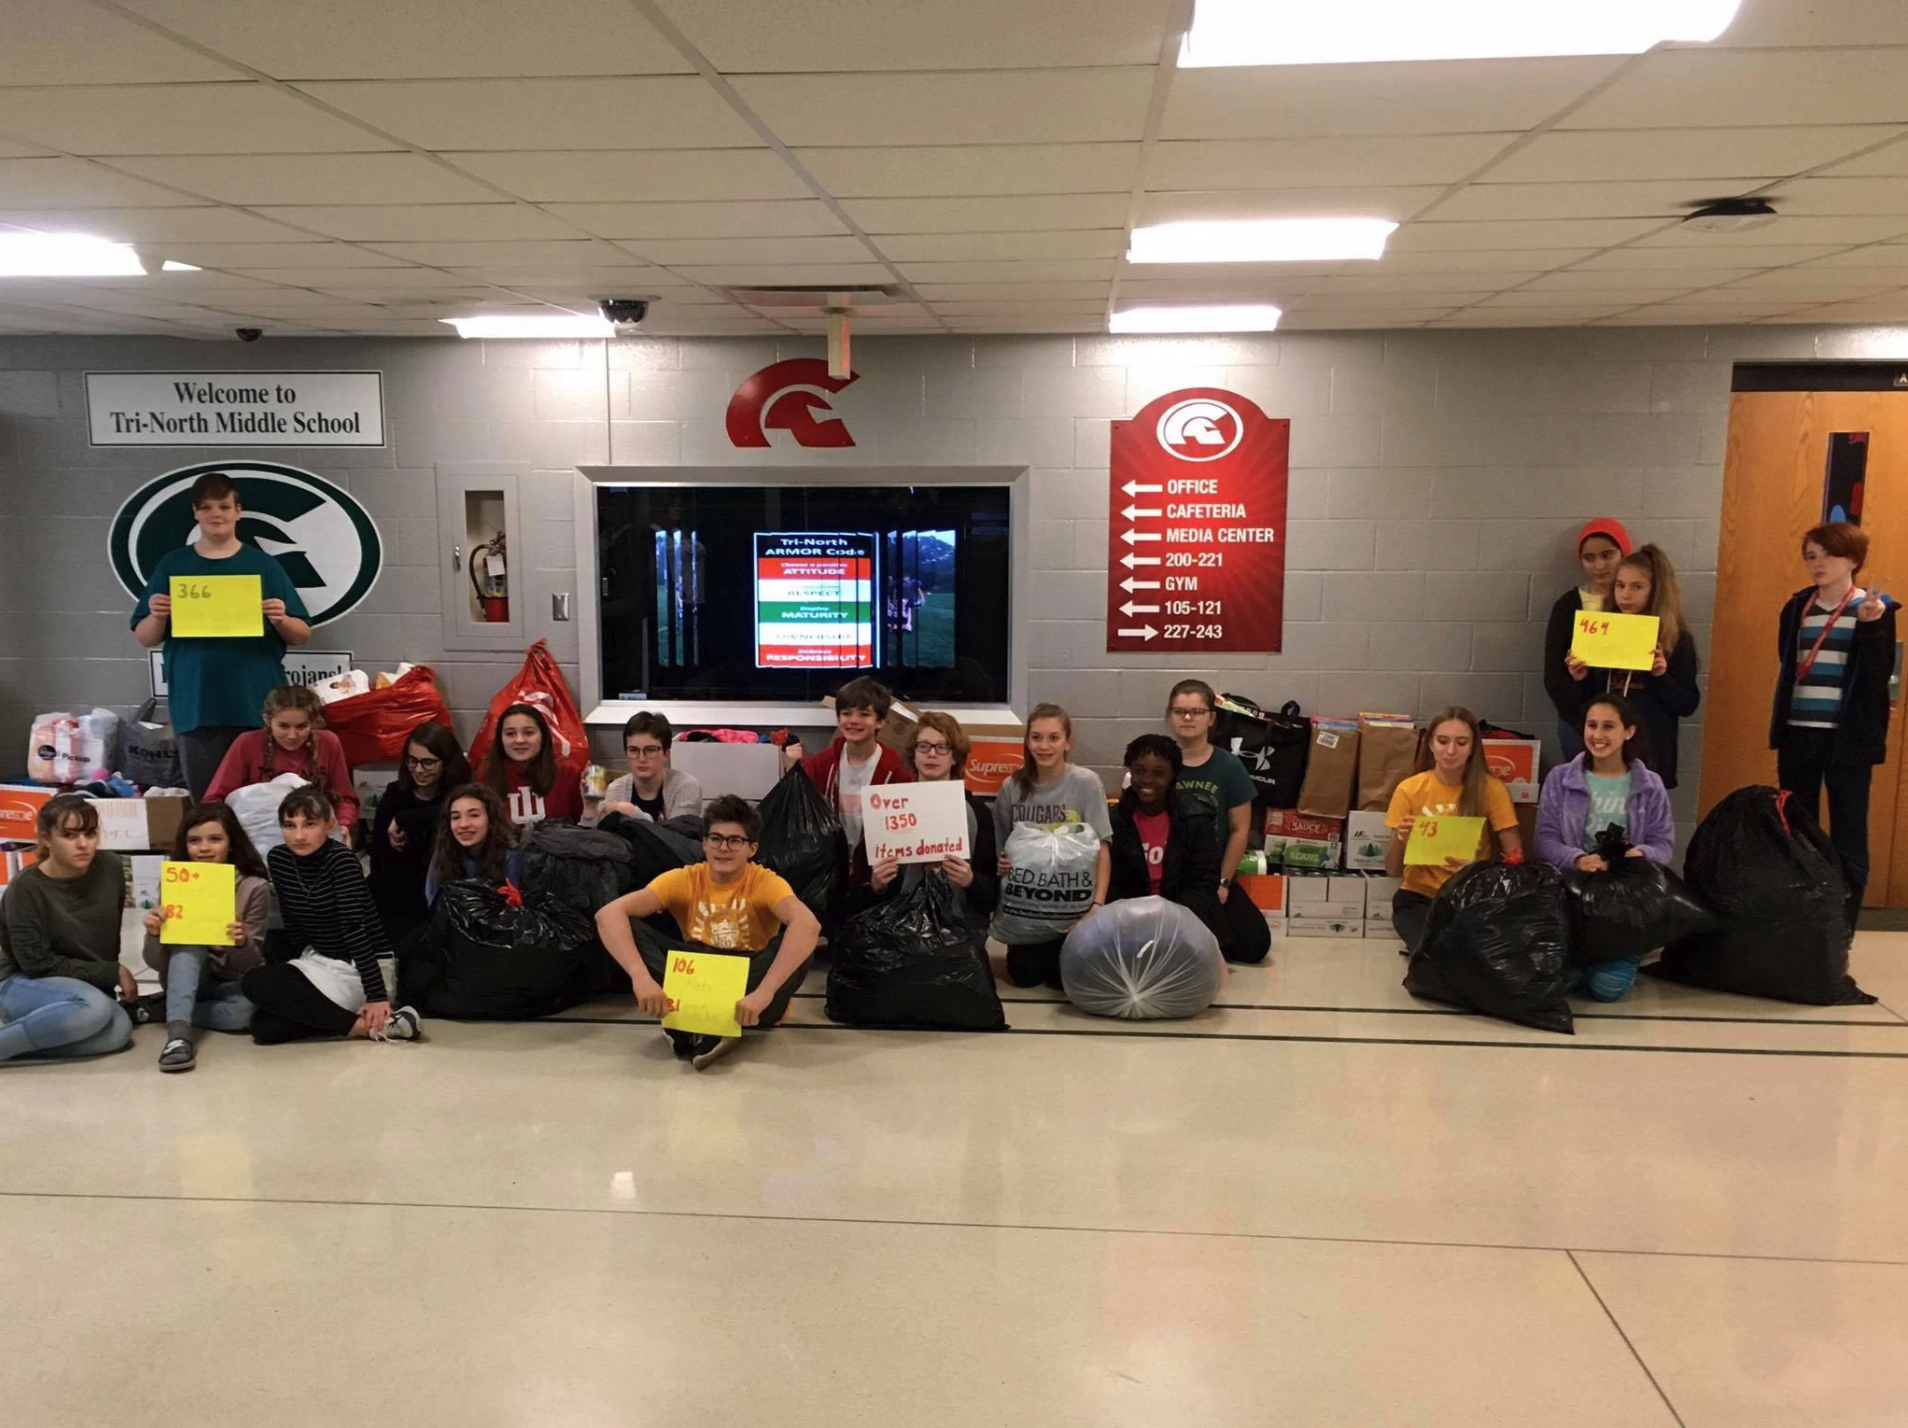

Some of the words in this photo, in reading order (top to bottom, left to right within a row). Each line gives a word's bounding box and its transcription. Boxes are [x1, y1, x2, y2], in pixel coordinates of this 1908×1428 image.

[173, 382, 269, 404] Welcome
[276, 382, 296, 404] to
[110, 411, 209, 434] Tri-North
[215, 411, 288, 434] Middle
[292, 411, 360, 434] School
[1167, 479, 1218, 495] OFFICE
[1166, 504, 1247, 519] CAFETERIA
[780, 538, 848, 546] Tri-North
[1166, 528, 1213, 543] MEDIA
[1217, 528, 1275, 543] CENTER
[765, 548, 822, 556] ARMOR
[826, 548, 865, 556] Code
[1165, 553, 1222, 567] 200-221
[177, 583, 212, 599] 366
[1165, 576, 1198, 591] GYM
[782, 611, 848, 619] MATURITY
[1164, 601, 1222, 615] 105-121
[1163, 624, 1223, 639] 227-243
[1579, 618, 1610, 636] 464
[766, 654, 866, 662] RESPONSIBILITY
[285, 665, 342, 688] ojans!
[969, 758, 1018, 777] Suprem
[1175, 780, 1220, 794] AWNEE
[869, 793, 909, 810] Over
[884, 813, 918, 831] 1350
[1291, 821, 1321, 834] SAUCE
[1419, 819, 1438, 838] 43
[875, 843, 913, 859] items
[915, 836, 963, 856] donated
[1289, 851, 1319, 861] BEANS
[166, 867, 200, 883] 50+
[1008, 867, 1036, 885] BED
[1037, 871, 1080, 888] BATH
[1081, 871, 1094, 888] &
[1005, 882, 1093, 903] BEYOND
[165, 904, 184, 920] 82
[672, 957, 696, 976] 106
